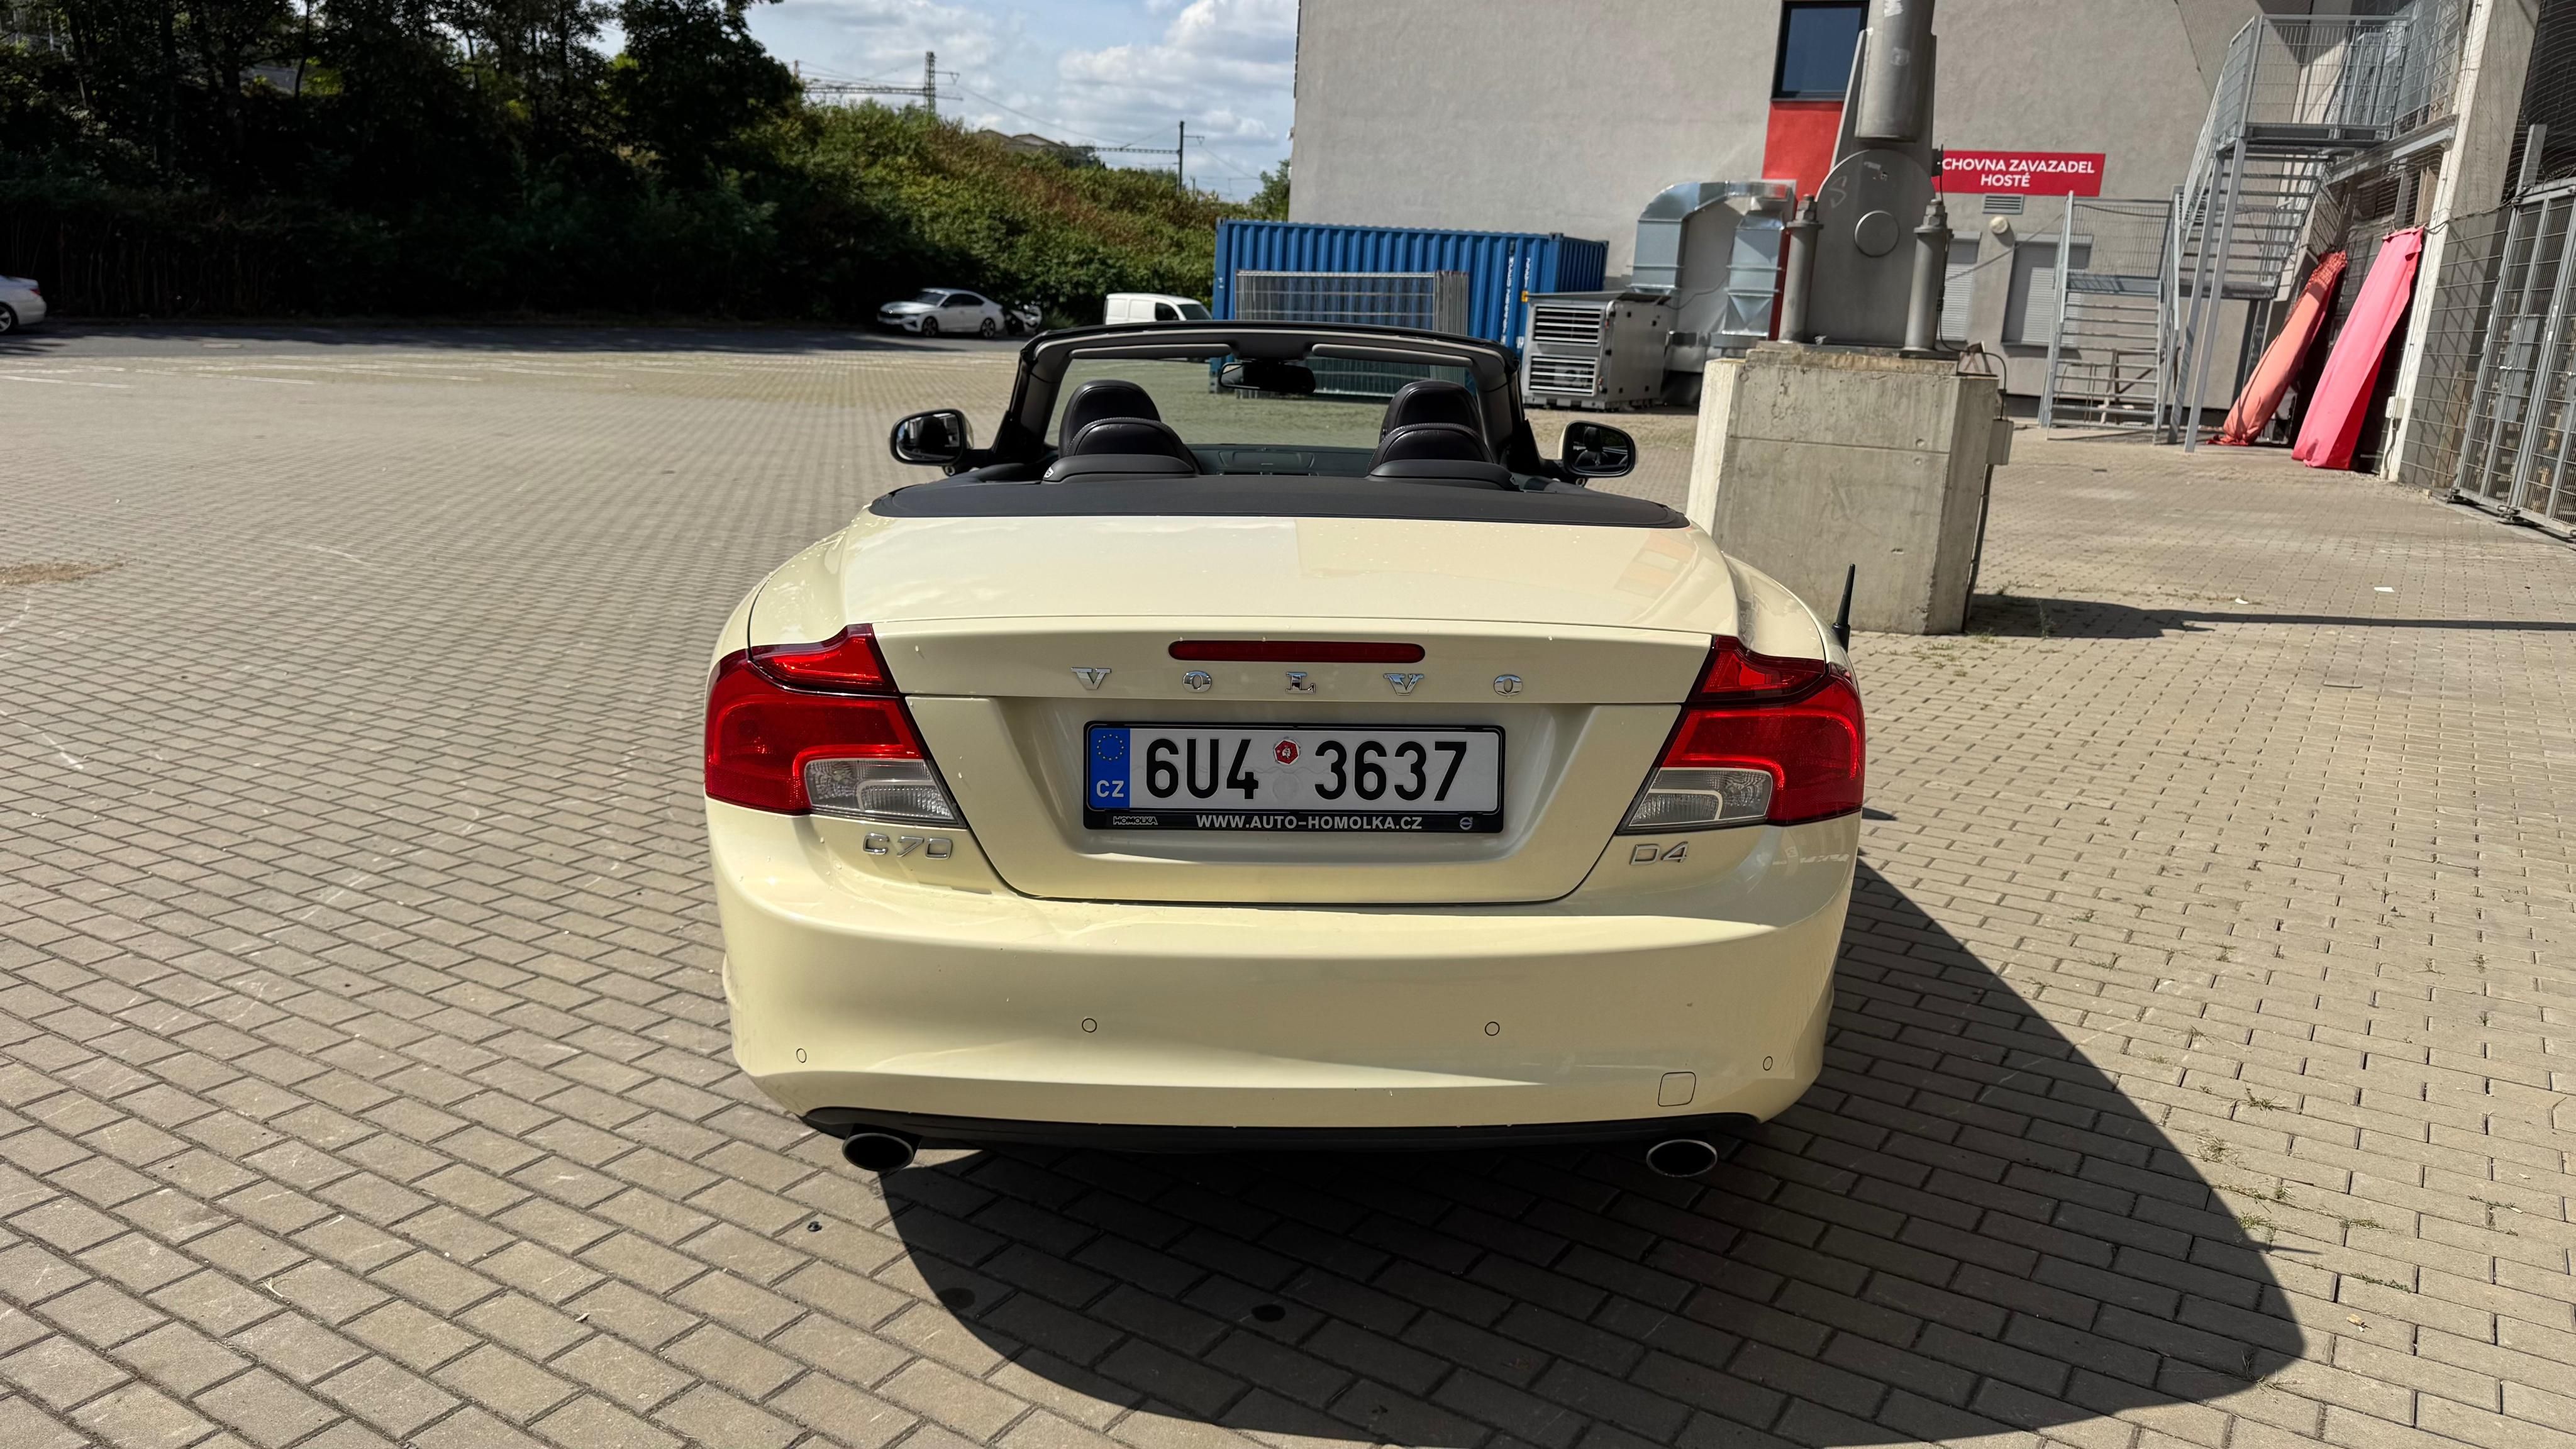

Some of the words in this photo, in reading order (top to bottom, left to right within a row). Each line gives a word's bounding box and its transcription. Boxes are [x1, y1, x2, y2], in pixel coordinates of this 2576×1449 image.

[1937, 158, 2006, 172] CHOVNA
[2009, 159, 2095, 174] ZAVAZADEL
[1980, 172, 2031, 187] HOSTÉ
[1071, 667, 1523, 696] VOLVO
[1096, 780, 1124, 798] CZ
[1145, 738, 1259, 800] 6U4
[1314, 740, 1468, 802] 3637
[1113, 816, 1158, 825] HOMOLKA
[1196, 814, 1423, 830] WWW.AUTO-HOMOLKA.CZ
[863, 832, 953, 860] C70
[1629, 841, 1688, 865] D4
